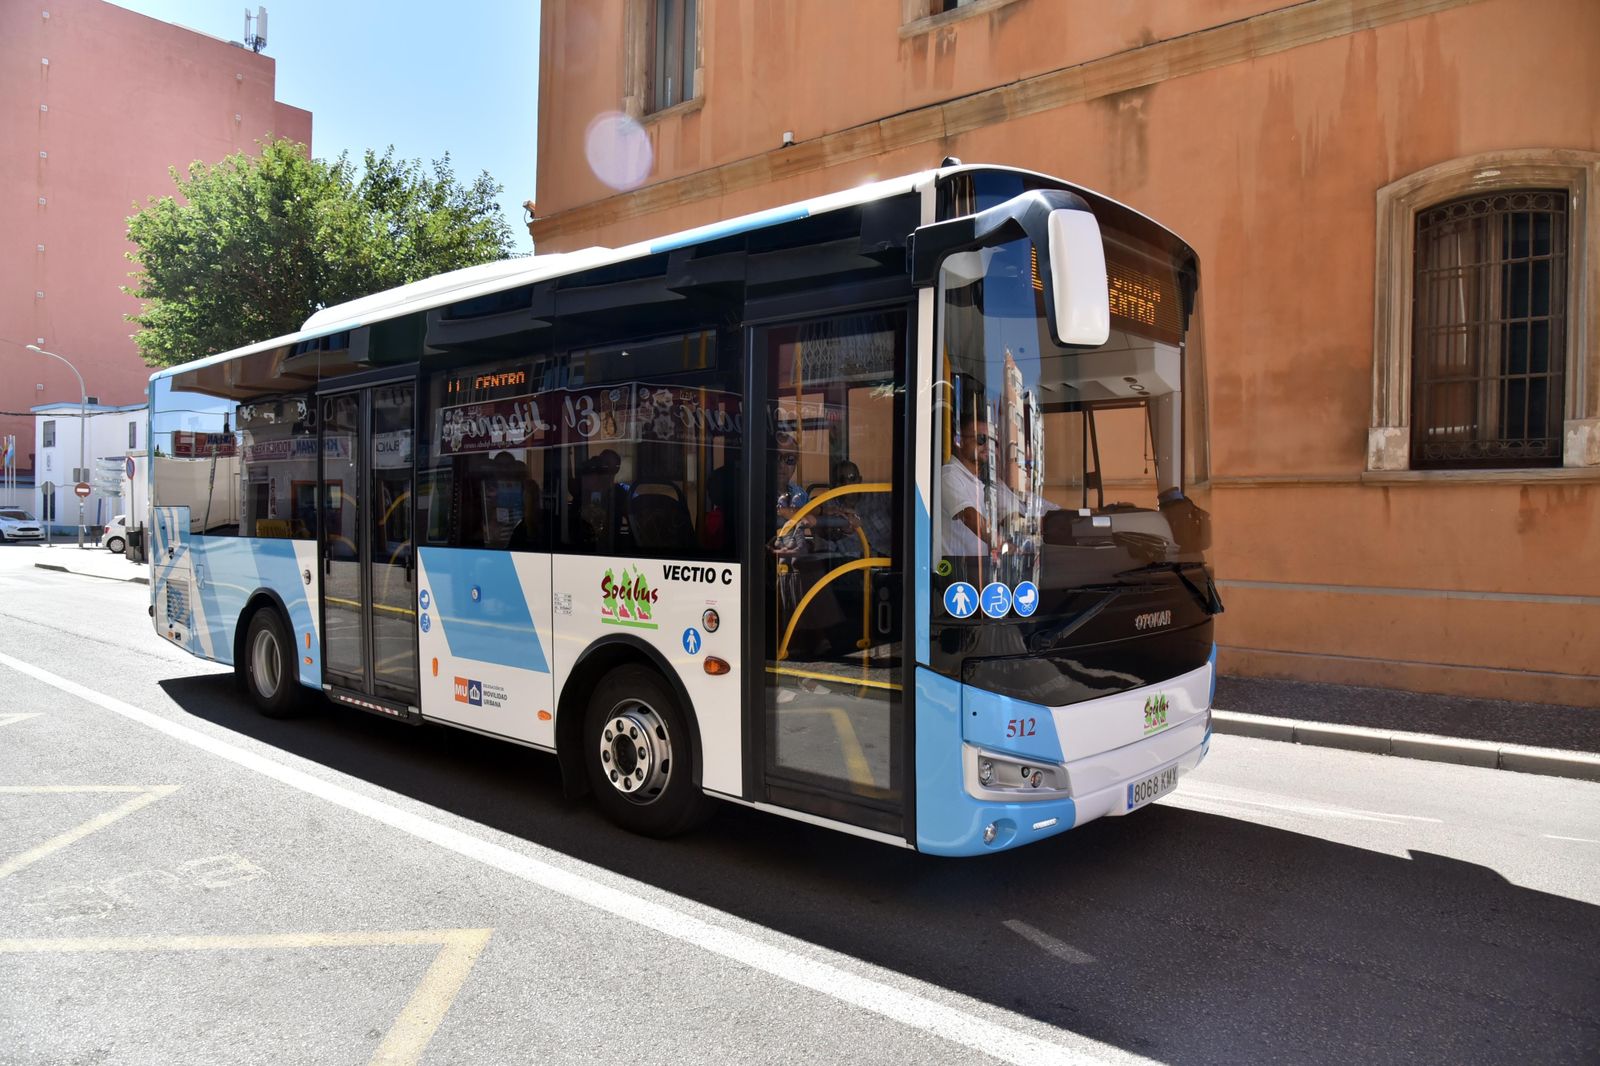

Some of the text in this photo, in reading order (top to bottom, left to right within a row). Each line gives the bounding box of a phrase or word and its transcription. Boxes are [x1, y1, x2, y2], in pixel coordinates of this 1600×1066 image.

[663, 565, 732, 585] VECTIO C
[601, 574, 658, 604] Socibus
[1135, 610, 1171, 630] OTOKAR
[455, 683, 468, 697] MU
[483, 690, 508, 701] MOVILIDAD
[483, 699, 502, 708] URBANA
[1006, 718, 1036, 738] 512
[1134, 766, 1178, 803] 8068 KMX
